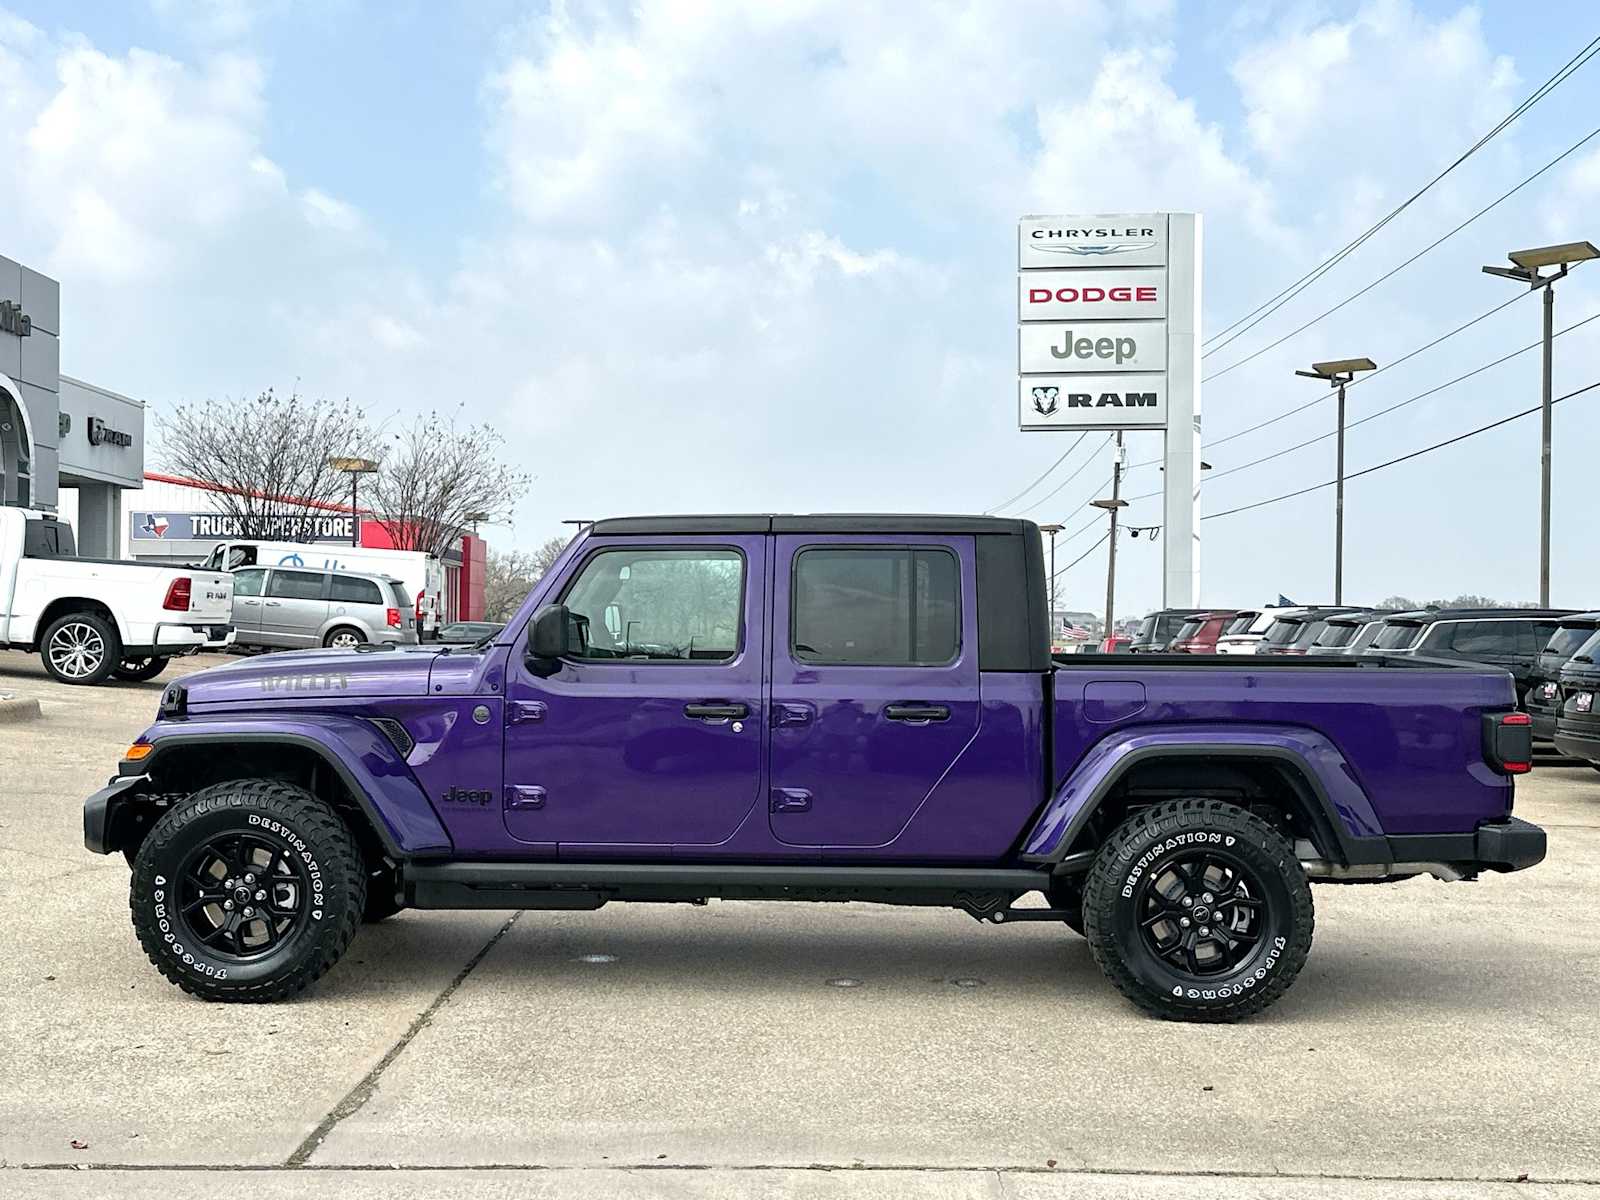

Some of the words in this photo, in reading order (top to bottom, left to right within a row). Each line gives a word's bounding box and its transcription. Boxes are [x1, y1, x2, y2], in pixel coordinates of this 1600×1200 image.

[1031, 228, 1154, 239] CHRYSLER
[1029, 287, 1157, 303] DODGE
[1051, 330, 1137, 364] Jeep
[1068, 392, 1157, 408] RAM
[190, 515, 244, 536] TRUCK
[441, 785, 493, 807] Jeep
[248, 814, 323, 905] DESTINATION
[1122, 831, 1222, 898] DESTINATION
